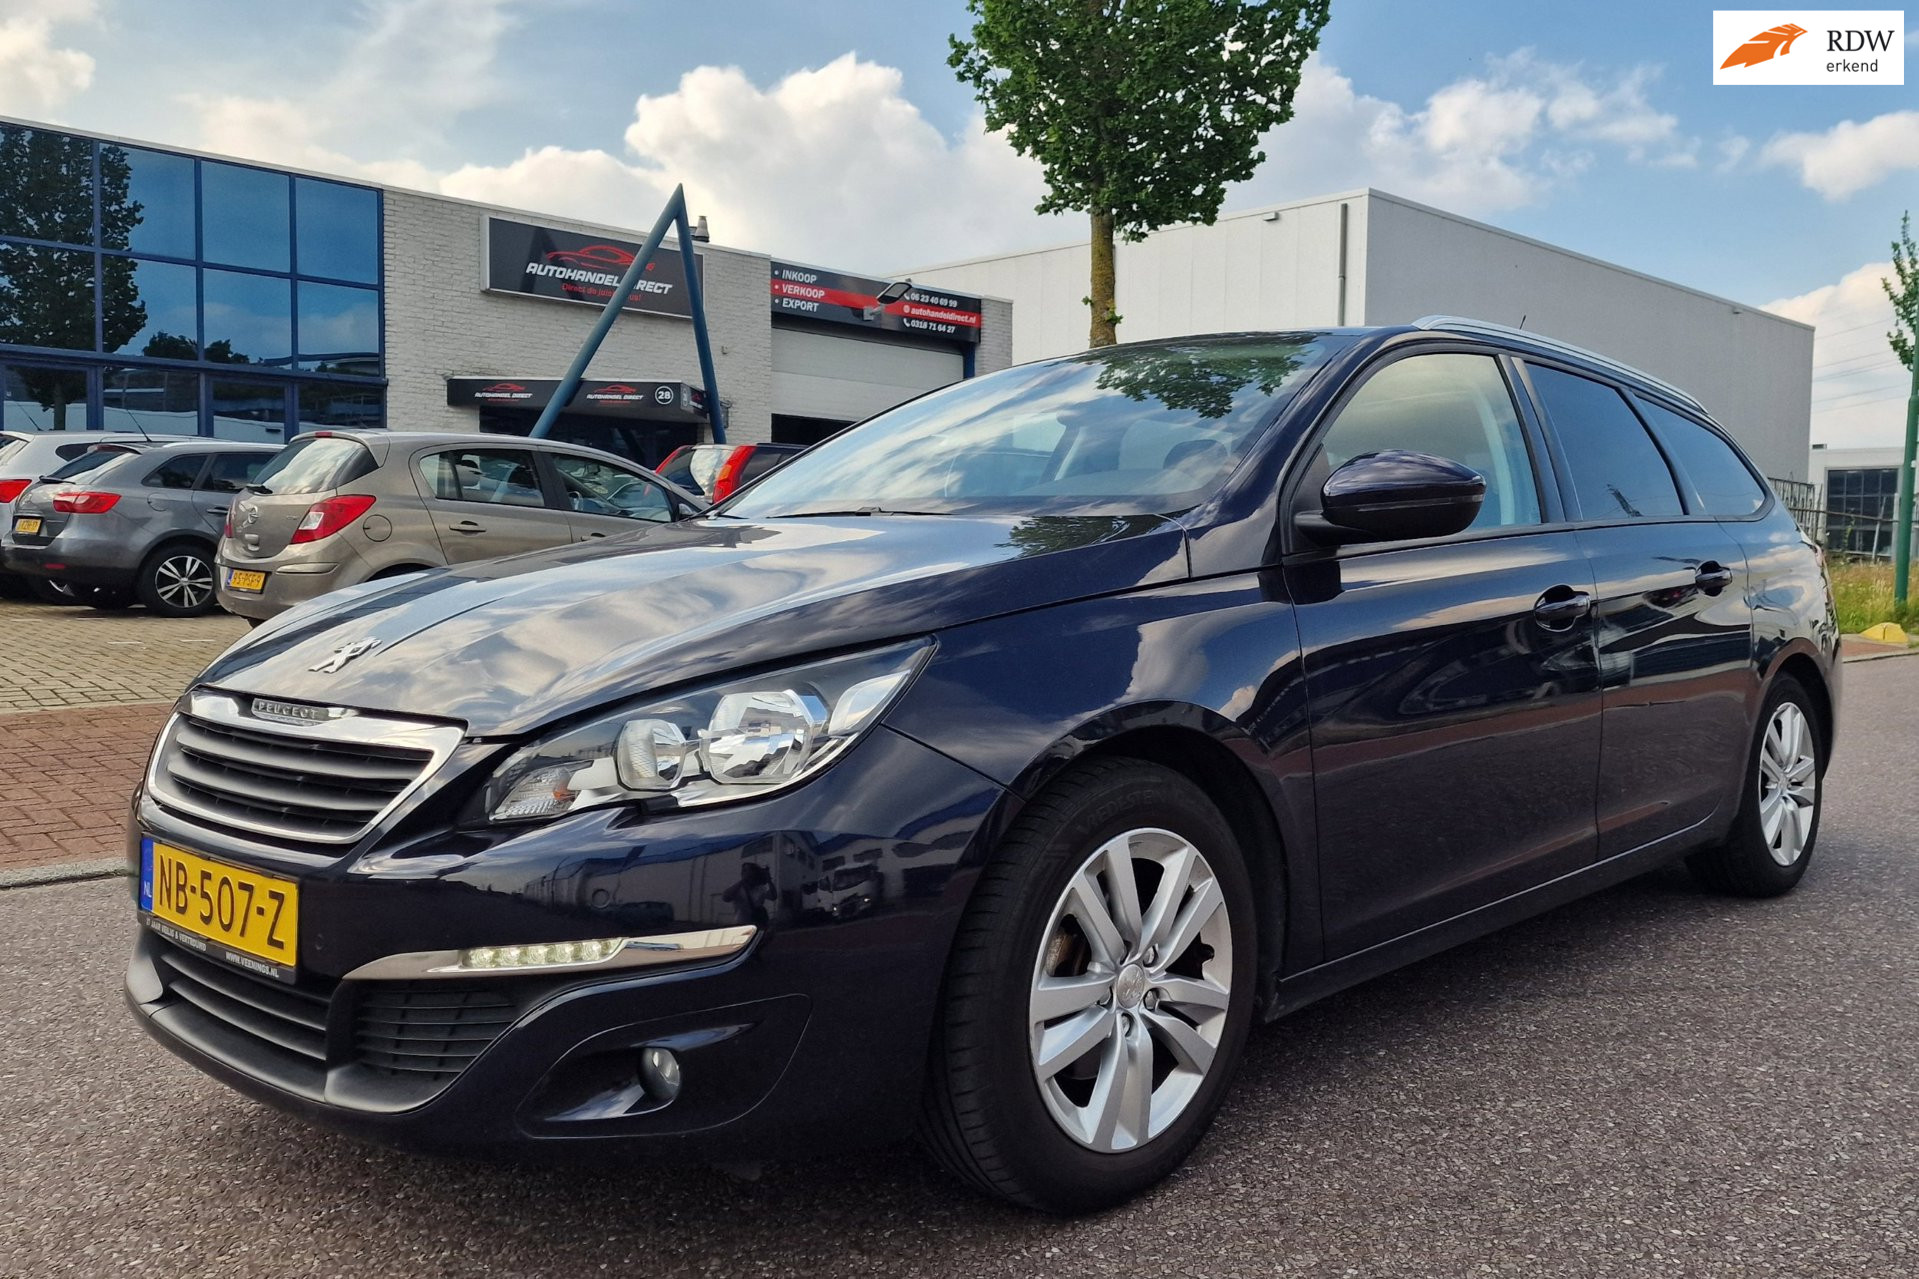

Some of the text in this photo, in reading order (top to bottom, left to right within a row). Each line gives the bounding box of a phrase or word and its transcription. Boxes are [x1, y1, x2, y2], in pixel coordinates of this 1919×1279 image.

[525, 262, 673, 295] AUTOHANDEL RECT
[782, 269, 817, 284] INKOOP
[782, 283, 825, 299] VERKOOP
[910, 292, 920, 301] 06
[920, 294, 930, 303] 23
[930, 296, 939, 305] 40
[782, 297, 819, 313] EXPORT
[911, 307, 977, 324] autohandeldirect.nl
[928, 322, 937, 331] 71
[946, 325, 956, 334] 27
[658, 390, 671, 400] 28
[258, 701, 319, 719] PEUGEOT
[143, 880, 153, 899] NL
[159, 854, 285, 951] NB-507-Z
